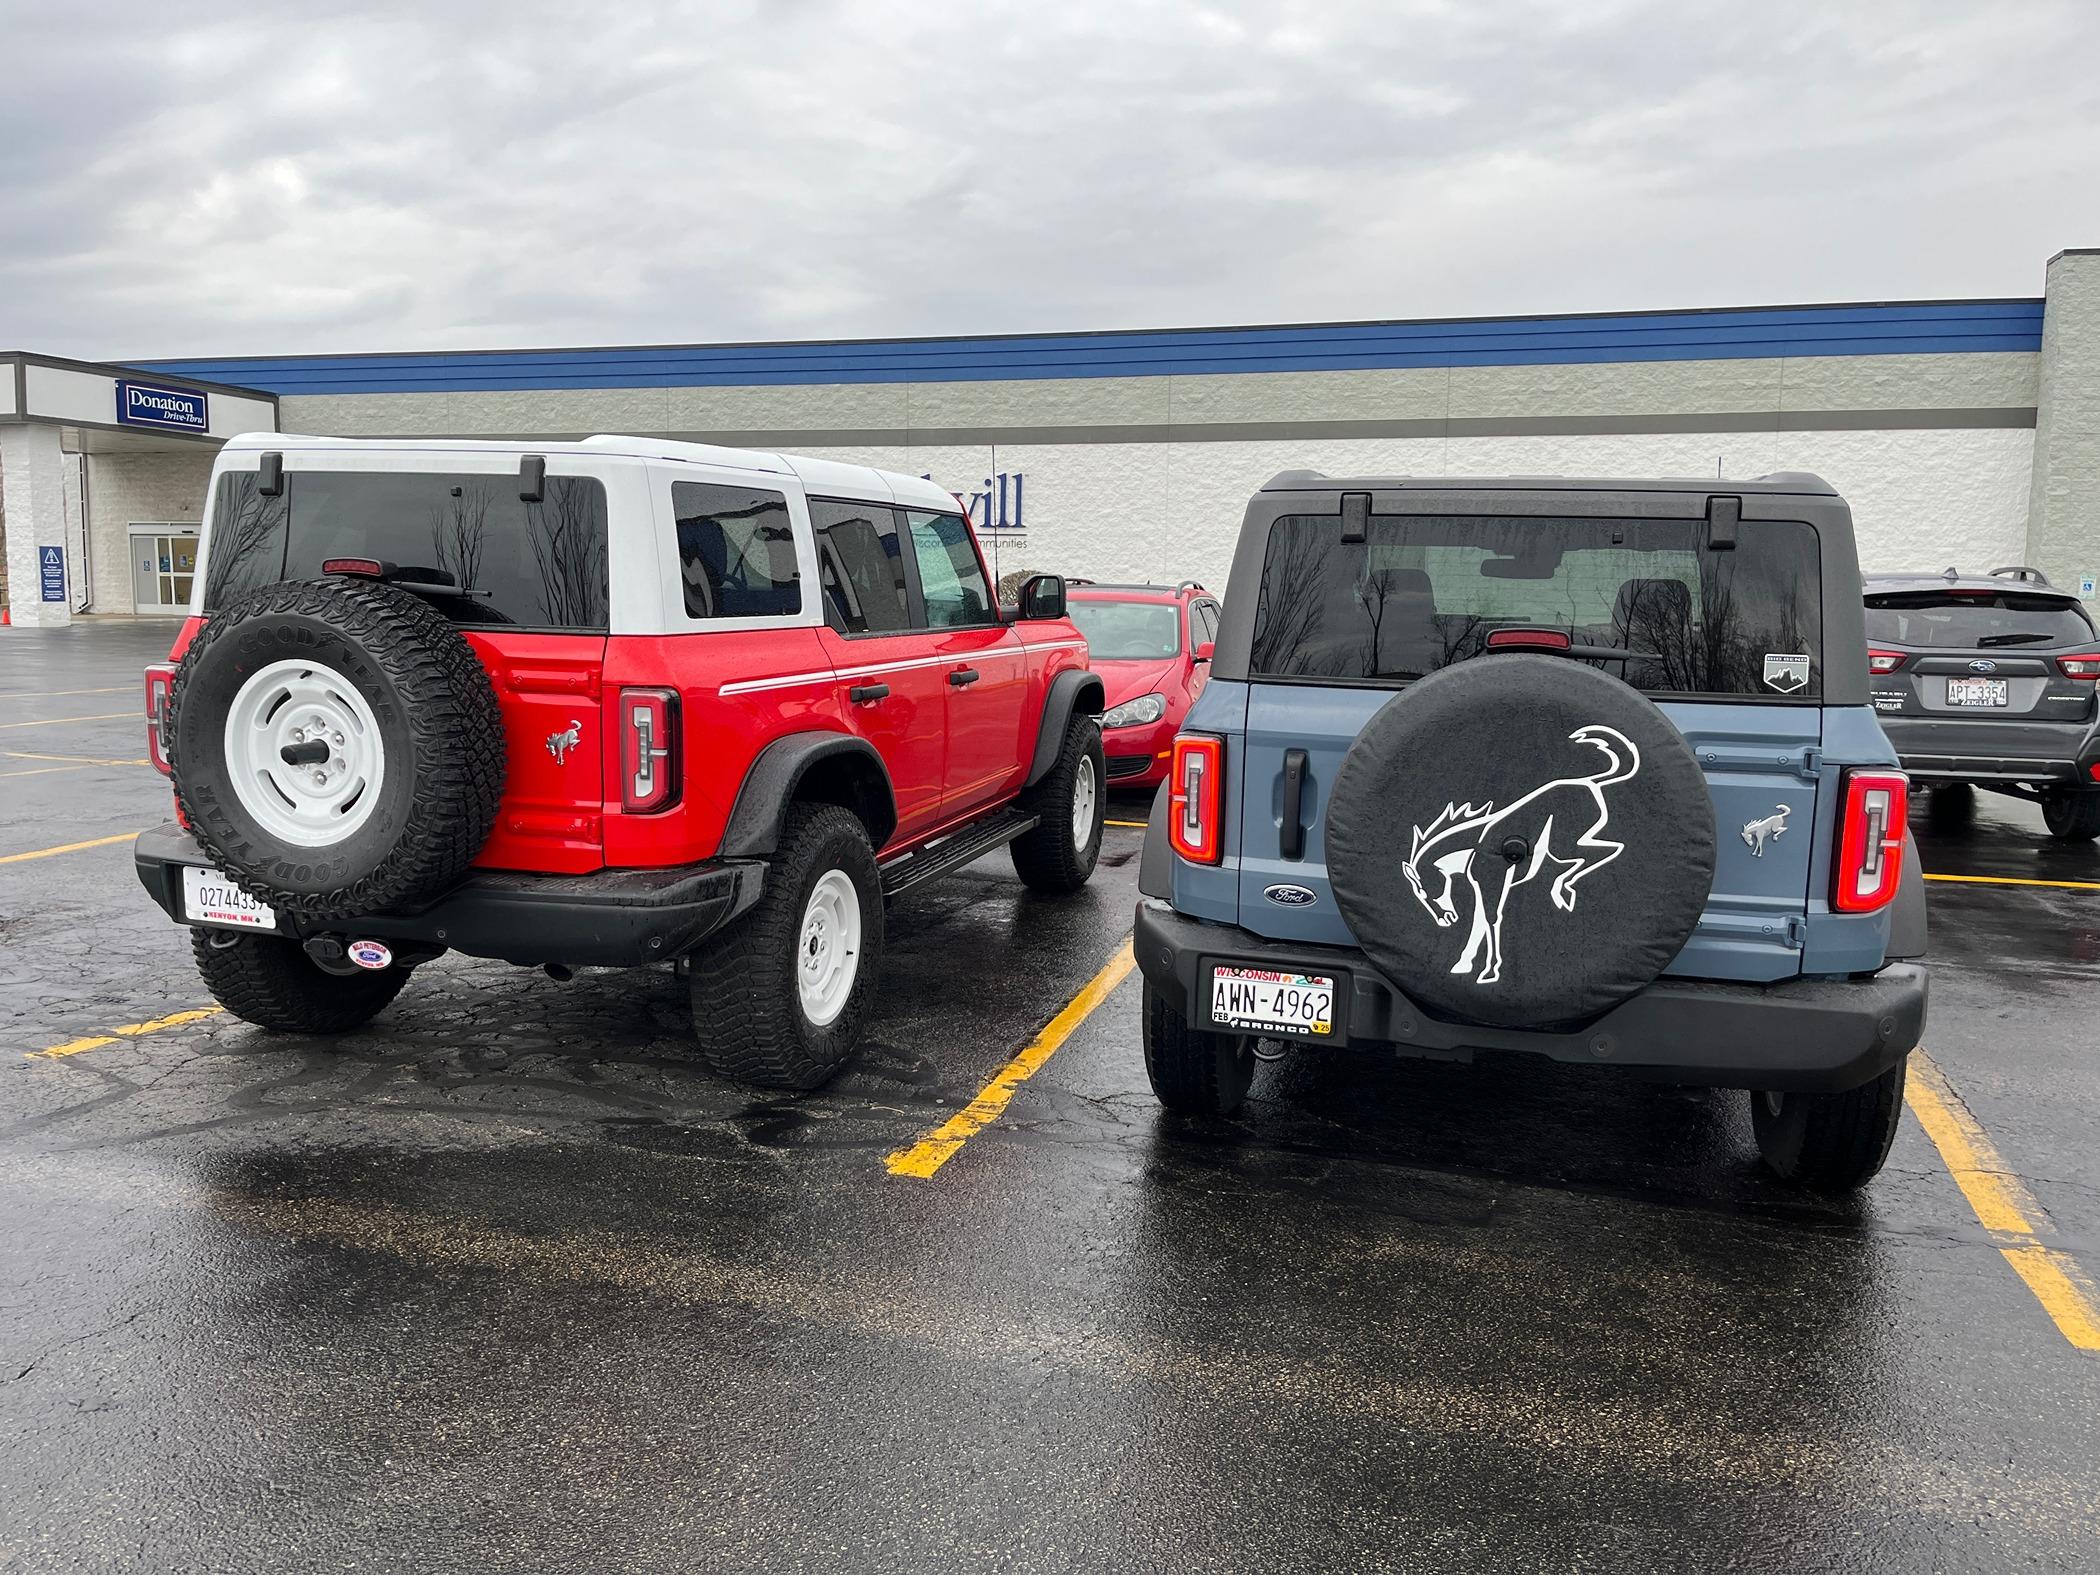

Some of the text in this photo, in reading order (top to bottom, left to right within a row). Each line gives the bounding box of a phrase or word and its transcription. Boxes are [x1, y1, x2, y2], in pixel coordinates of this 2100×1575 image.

[130, 390, 194, 413] Donation
[163, 410, 203, 424] Drive-Thru
[1949, 685, 2005, 700] APT-3354
[1275, 888, 1304, 903] Ford
[1214, 982, 1330, 1022] AWN-4962
[1213, 1011, 1229, 1021] FEB
[1240, 1020, 1309, 1034] BRONCO
[1320, 1024, 1330, 1032] 25
